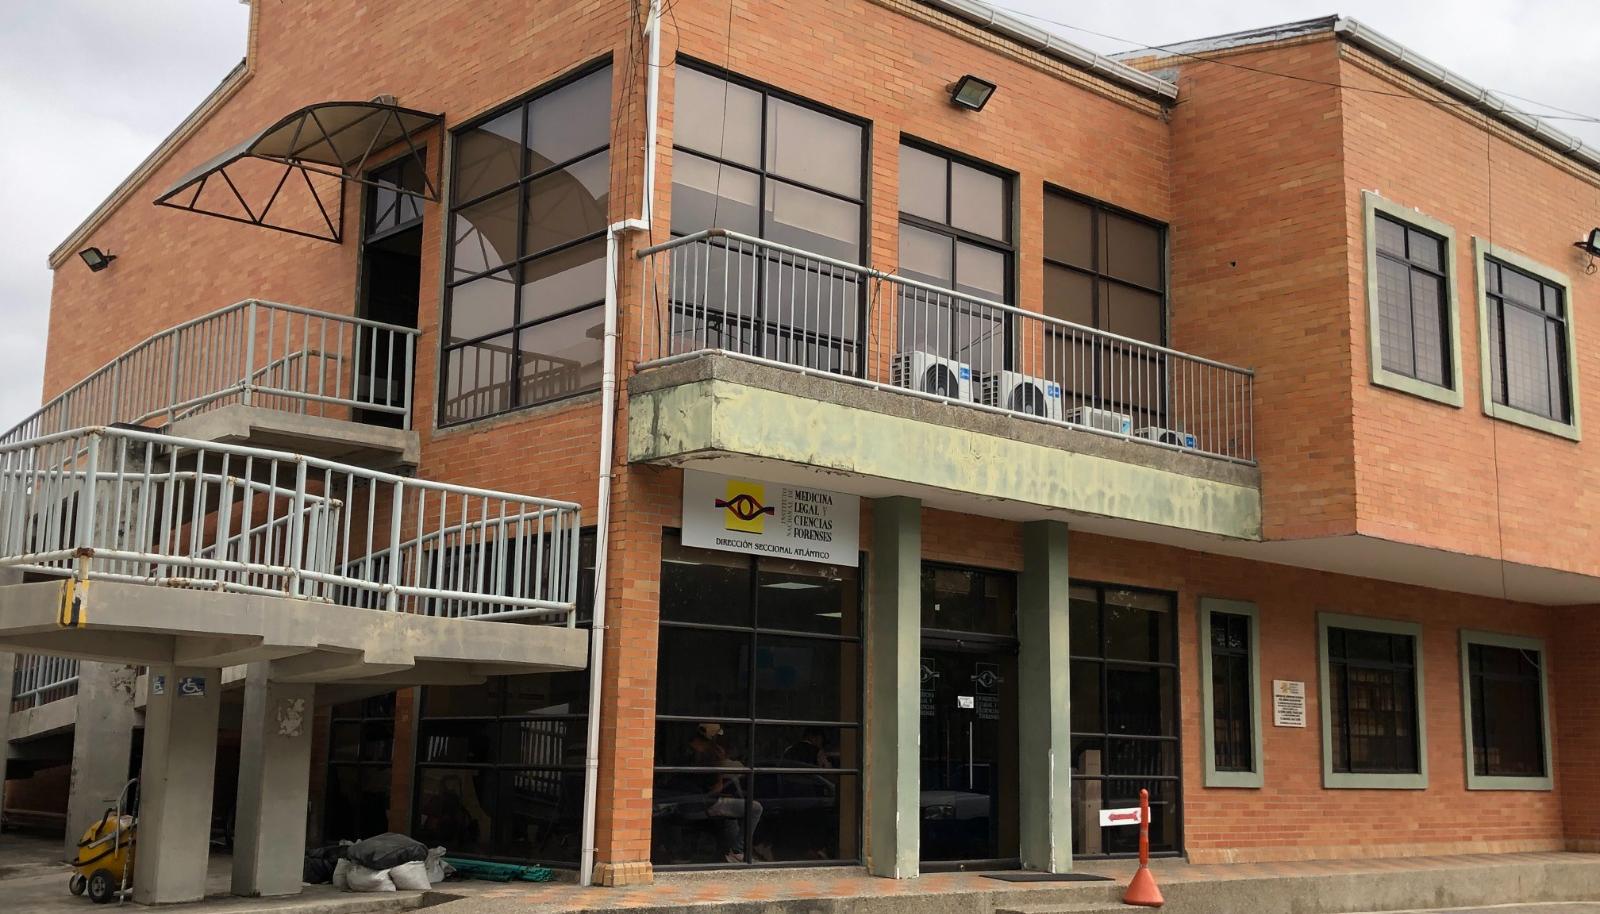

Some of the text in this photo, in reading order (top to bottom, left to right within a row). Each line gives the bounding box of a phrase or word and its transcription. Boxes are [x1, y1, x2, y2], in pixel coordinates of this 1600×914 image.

[795, 490, 833, 506] MEDICINA
[794, 502, 820, 516] LEGAL
[794, 515, 833, 530] CIENCIAS
[794, 527, 833, 542] FORENSES
[716, 538, 830, 560] DIRECCIÓN SECCIONAL ATLÁNTICO
